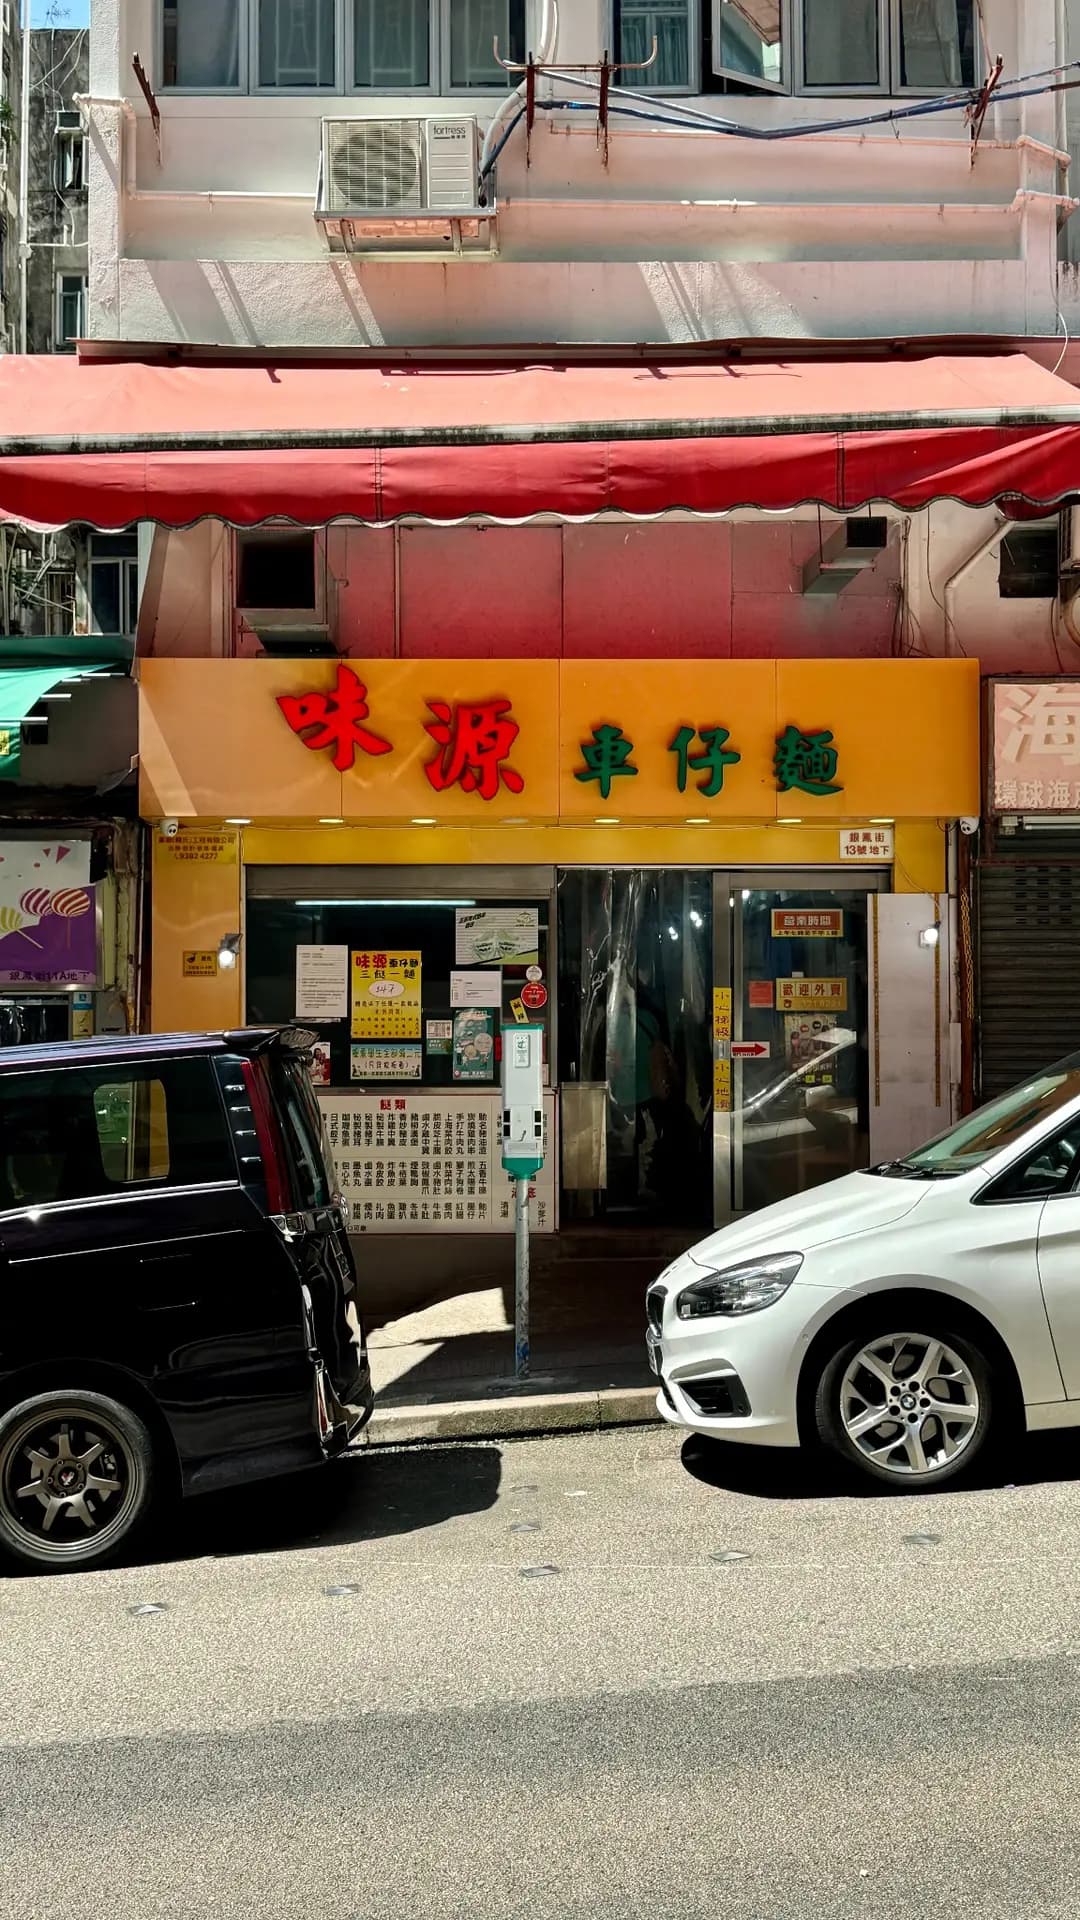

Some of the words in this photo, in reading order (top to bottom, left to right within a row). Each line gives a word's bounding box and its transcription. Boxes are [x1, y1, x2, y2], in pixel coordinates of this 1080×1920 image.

[433, 126, 466, 135] fortress
[575, 724, 844, 799] 車仔麵
[995, 780, 1080, 808] 環球海
[849, 832, 885, 842] 銀鳳街
[844, 845, 889, 855] 13號地下
